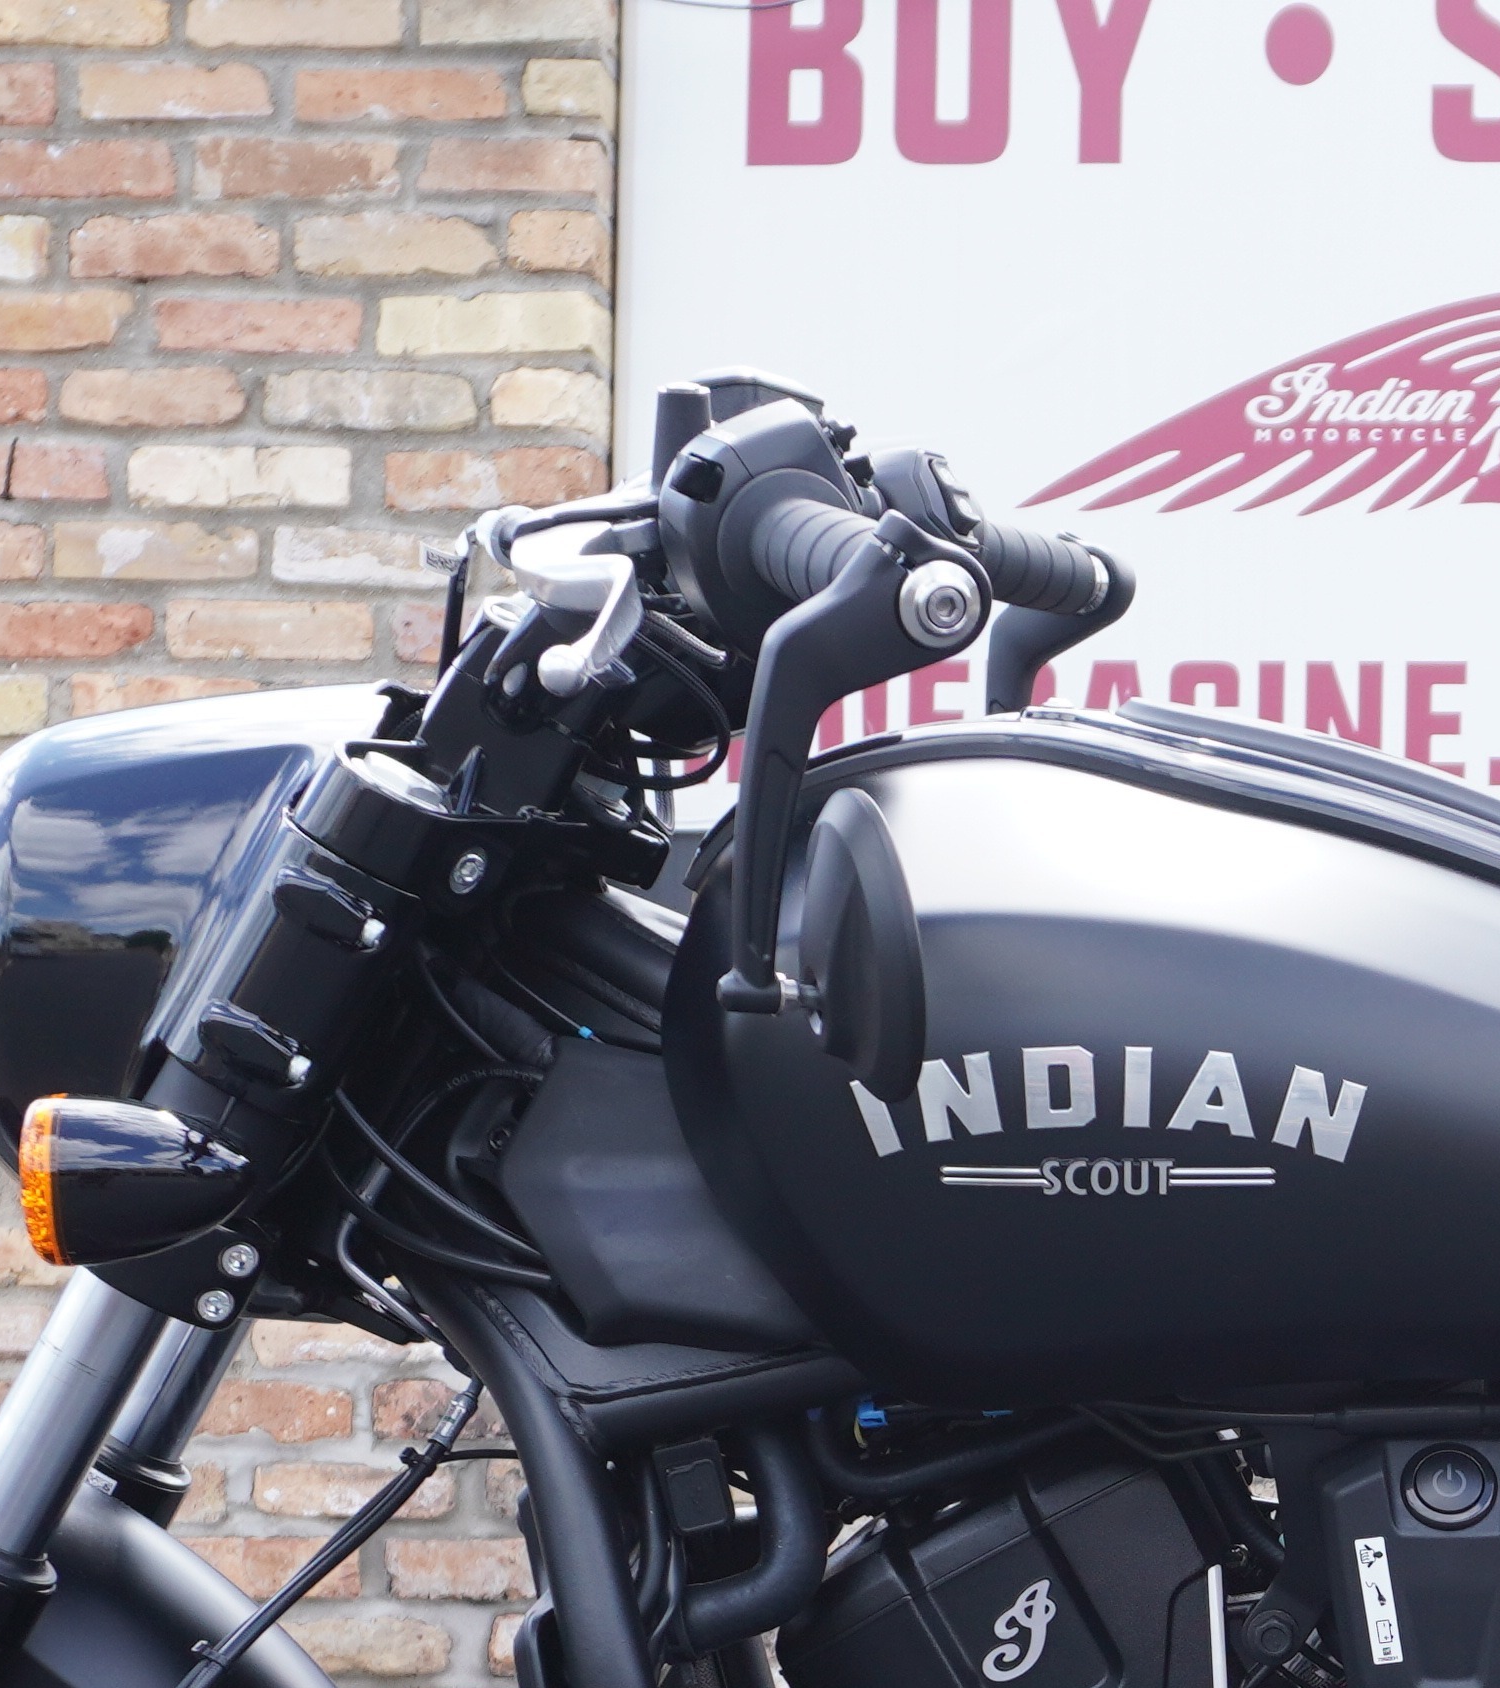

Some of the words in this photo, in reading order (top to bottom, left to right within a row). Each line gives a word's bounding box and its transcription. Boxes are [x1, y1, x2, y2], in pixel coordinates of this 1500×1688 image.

[745, 0, 1151, 167] BUY
[1244, 362, 1475, 424] Indian
[1253, 427, 1467, 445] MOTORCYCLE
[848, 1044, 1368, 1164] INDIAN
[1040, 1157, 1176, 1196] SCOUT
